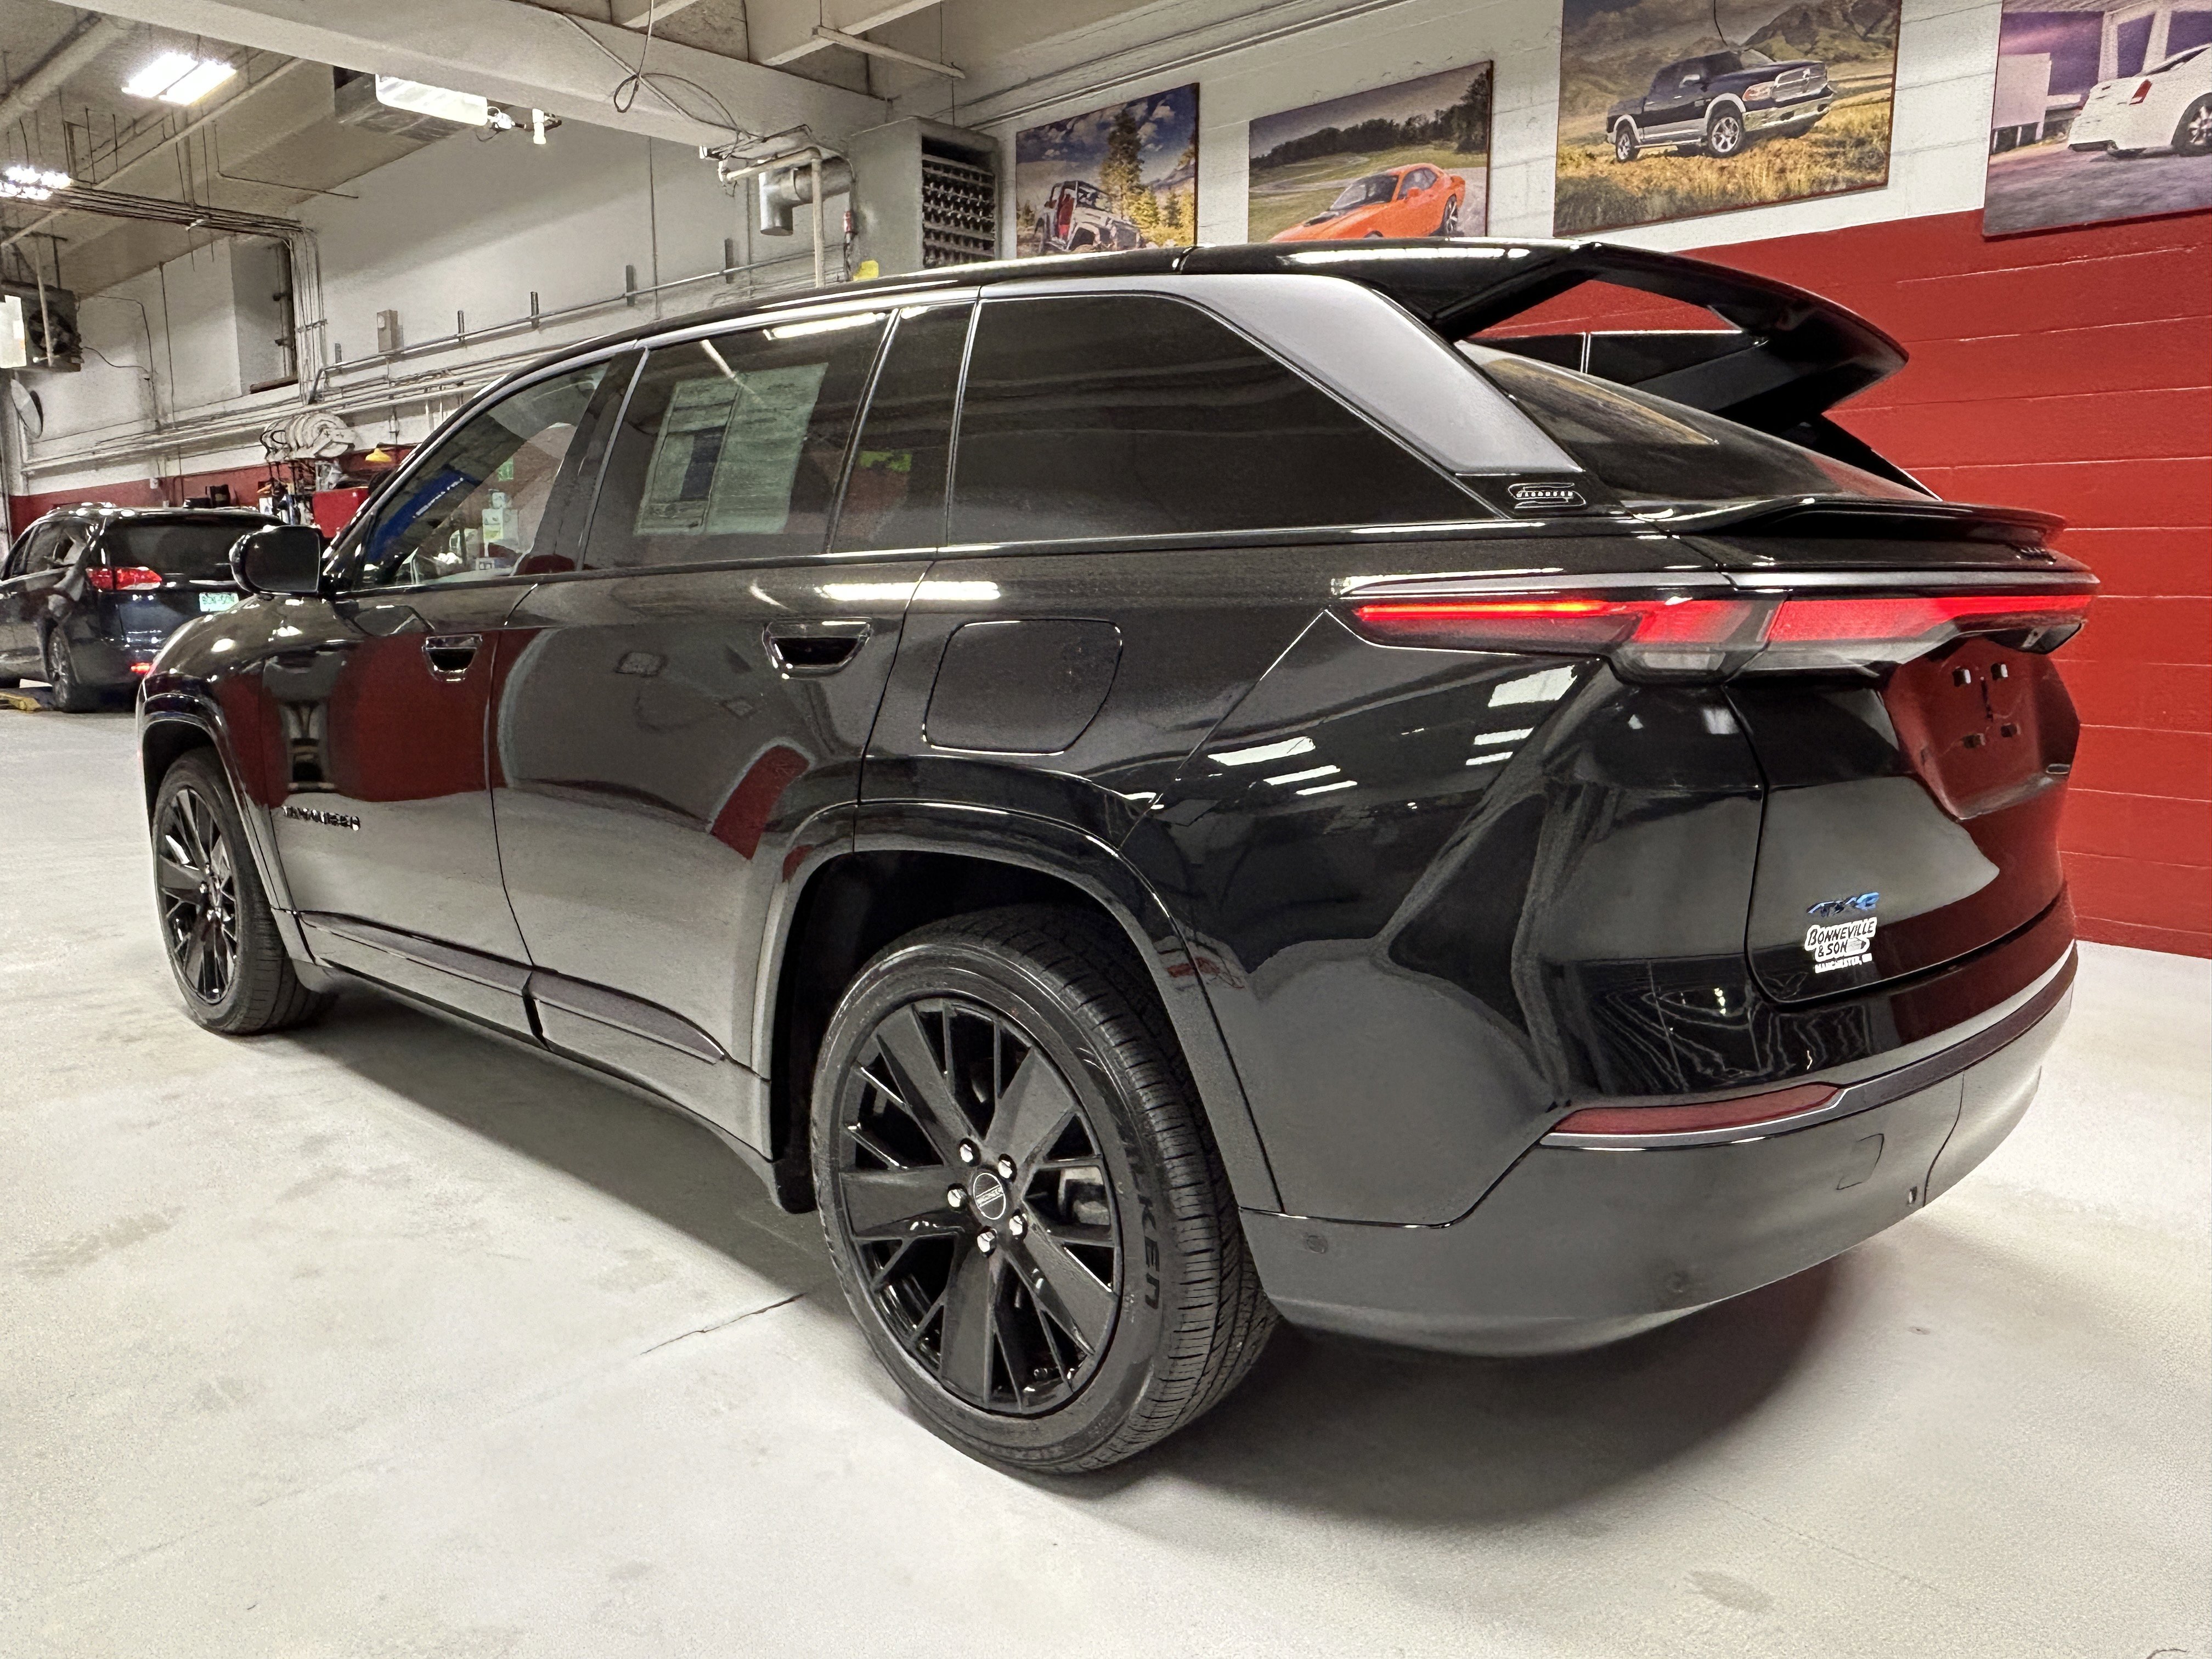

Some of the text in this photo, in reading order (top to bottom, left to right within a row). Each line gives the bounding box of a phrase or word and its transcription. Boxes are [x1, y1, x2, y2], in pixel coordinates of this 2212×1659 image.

[1808, 921, 1875, 946] BONNEVILLE
[1818, 939, 1848, 957] & SON
